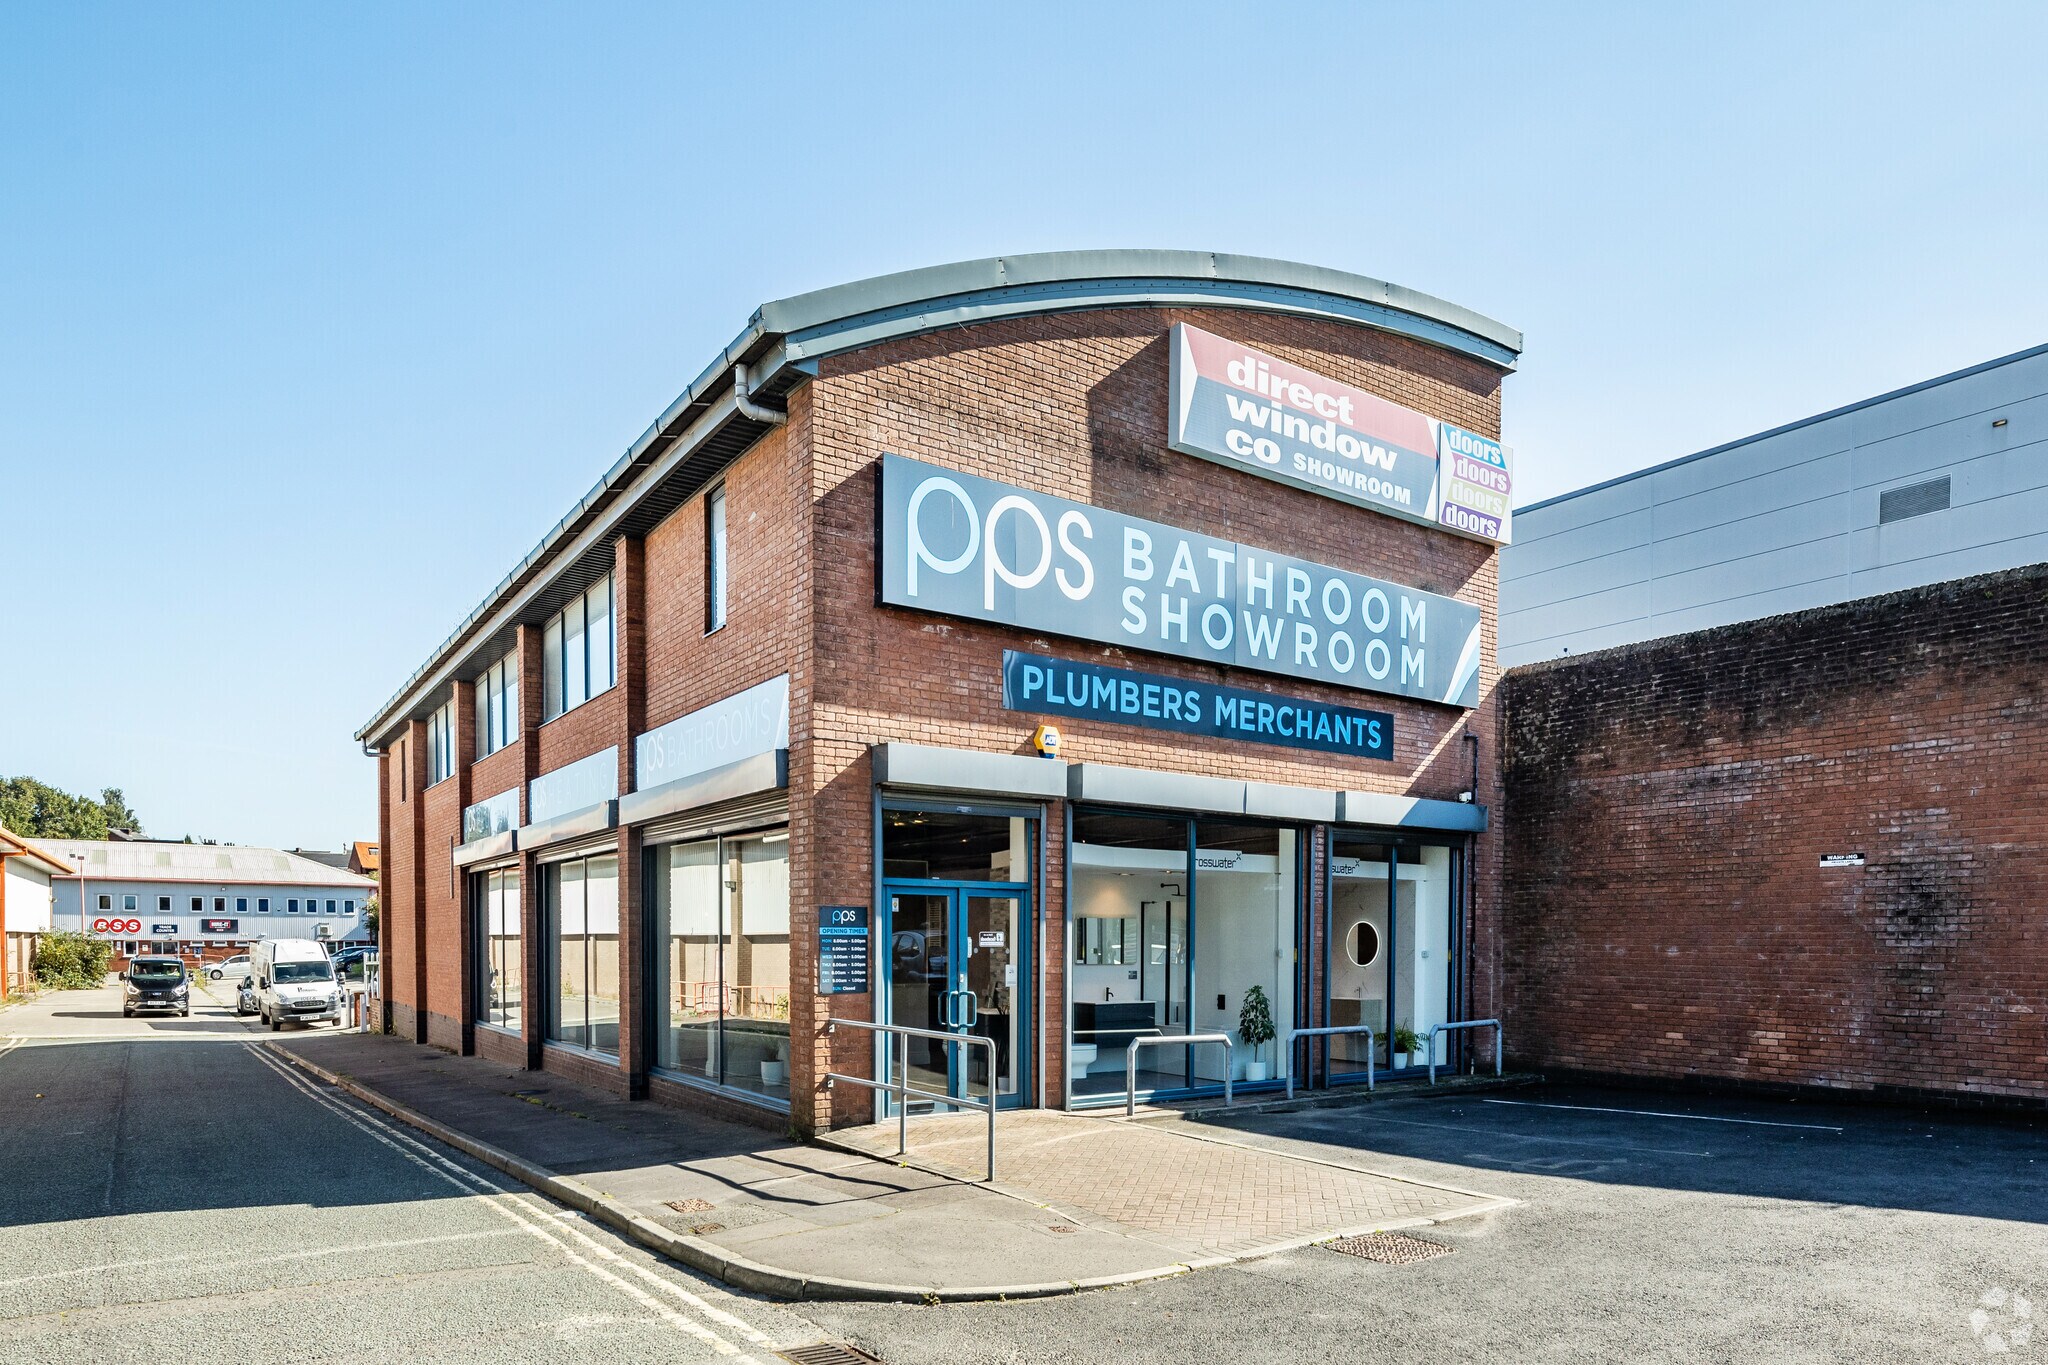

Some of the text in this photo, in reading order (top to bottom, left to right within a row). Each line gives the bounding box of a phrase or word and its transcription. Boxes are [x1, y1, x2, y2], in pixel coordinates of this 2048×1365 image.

[1226, 355, 1354, 426] direct
[1225, 394, 1398, 472] window
[1225, 429, 1411, 505] co SHOWROOM
[1449, 428, 1502, 466] doors
[1451, 481, 1504, 516] doors
[1456, 460, 1508, 493] doors
[906, 476, 1095, 611] pps
[1445, 504, 1499, 539] doors
[1122, 526, 1427, 644] BATHROOM
[1121, 585, 1426, 689] SHOWROOM
[667, 697, 771, 768] BATHROOMS
[1022, 664, 1383, 750] PLUMBERS MERCHANTS
[96, 920, 138, 931] RSS
[832, 910, 856, 925] pps
